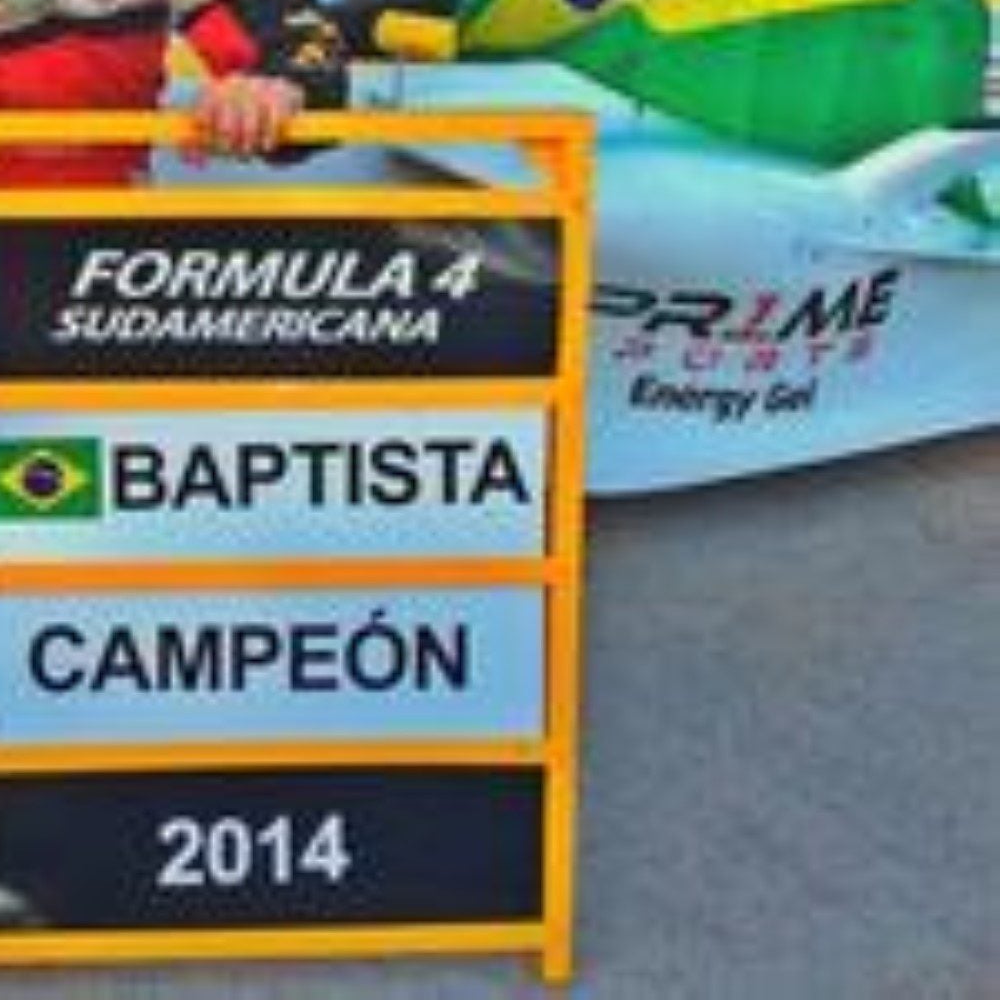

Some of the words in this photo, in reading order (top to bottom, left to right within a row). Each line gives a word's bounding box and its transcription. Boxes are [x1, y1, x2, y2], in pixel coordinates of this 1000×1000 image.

[70, 248, 415, 302] FORMULA
[431, 248, 485, 300] 4
[50, 302, 442, 347] SUDAMERICANA
[111, 438, 531, 512] BAPTISTA
[27, 609, 470, 694] CAMPEÓN
[157, 813, 352, 887] 2014
